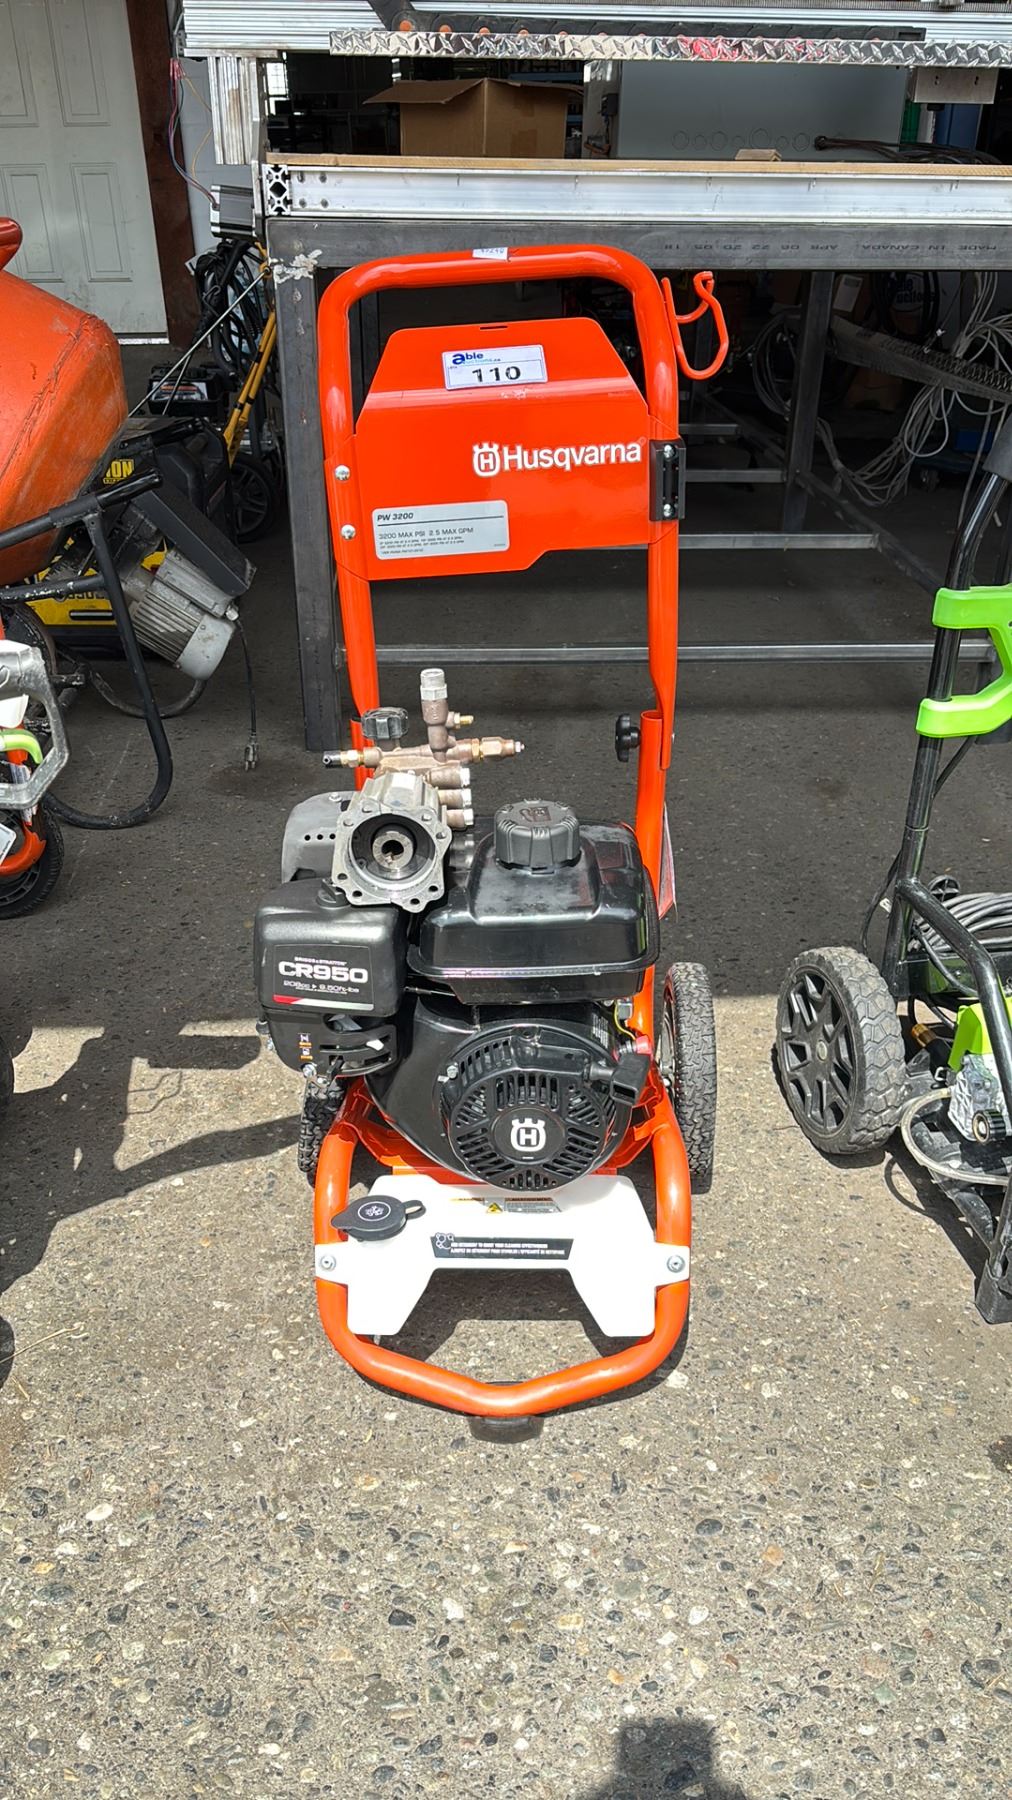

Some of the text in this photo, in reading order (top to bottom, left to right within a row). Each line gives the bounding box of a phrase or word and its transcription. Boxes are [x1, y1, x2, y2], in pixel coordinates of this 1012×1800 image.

[471, 366, 521, 382] 110
[502, 443, 641, 472] Husqvarna
[392, 512, 414, 521] 3200
[379, 532, 397, 540] 3200
[278, 961, 369, 984] CR950
